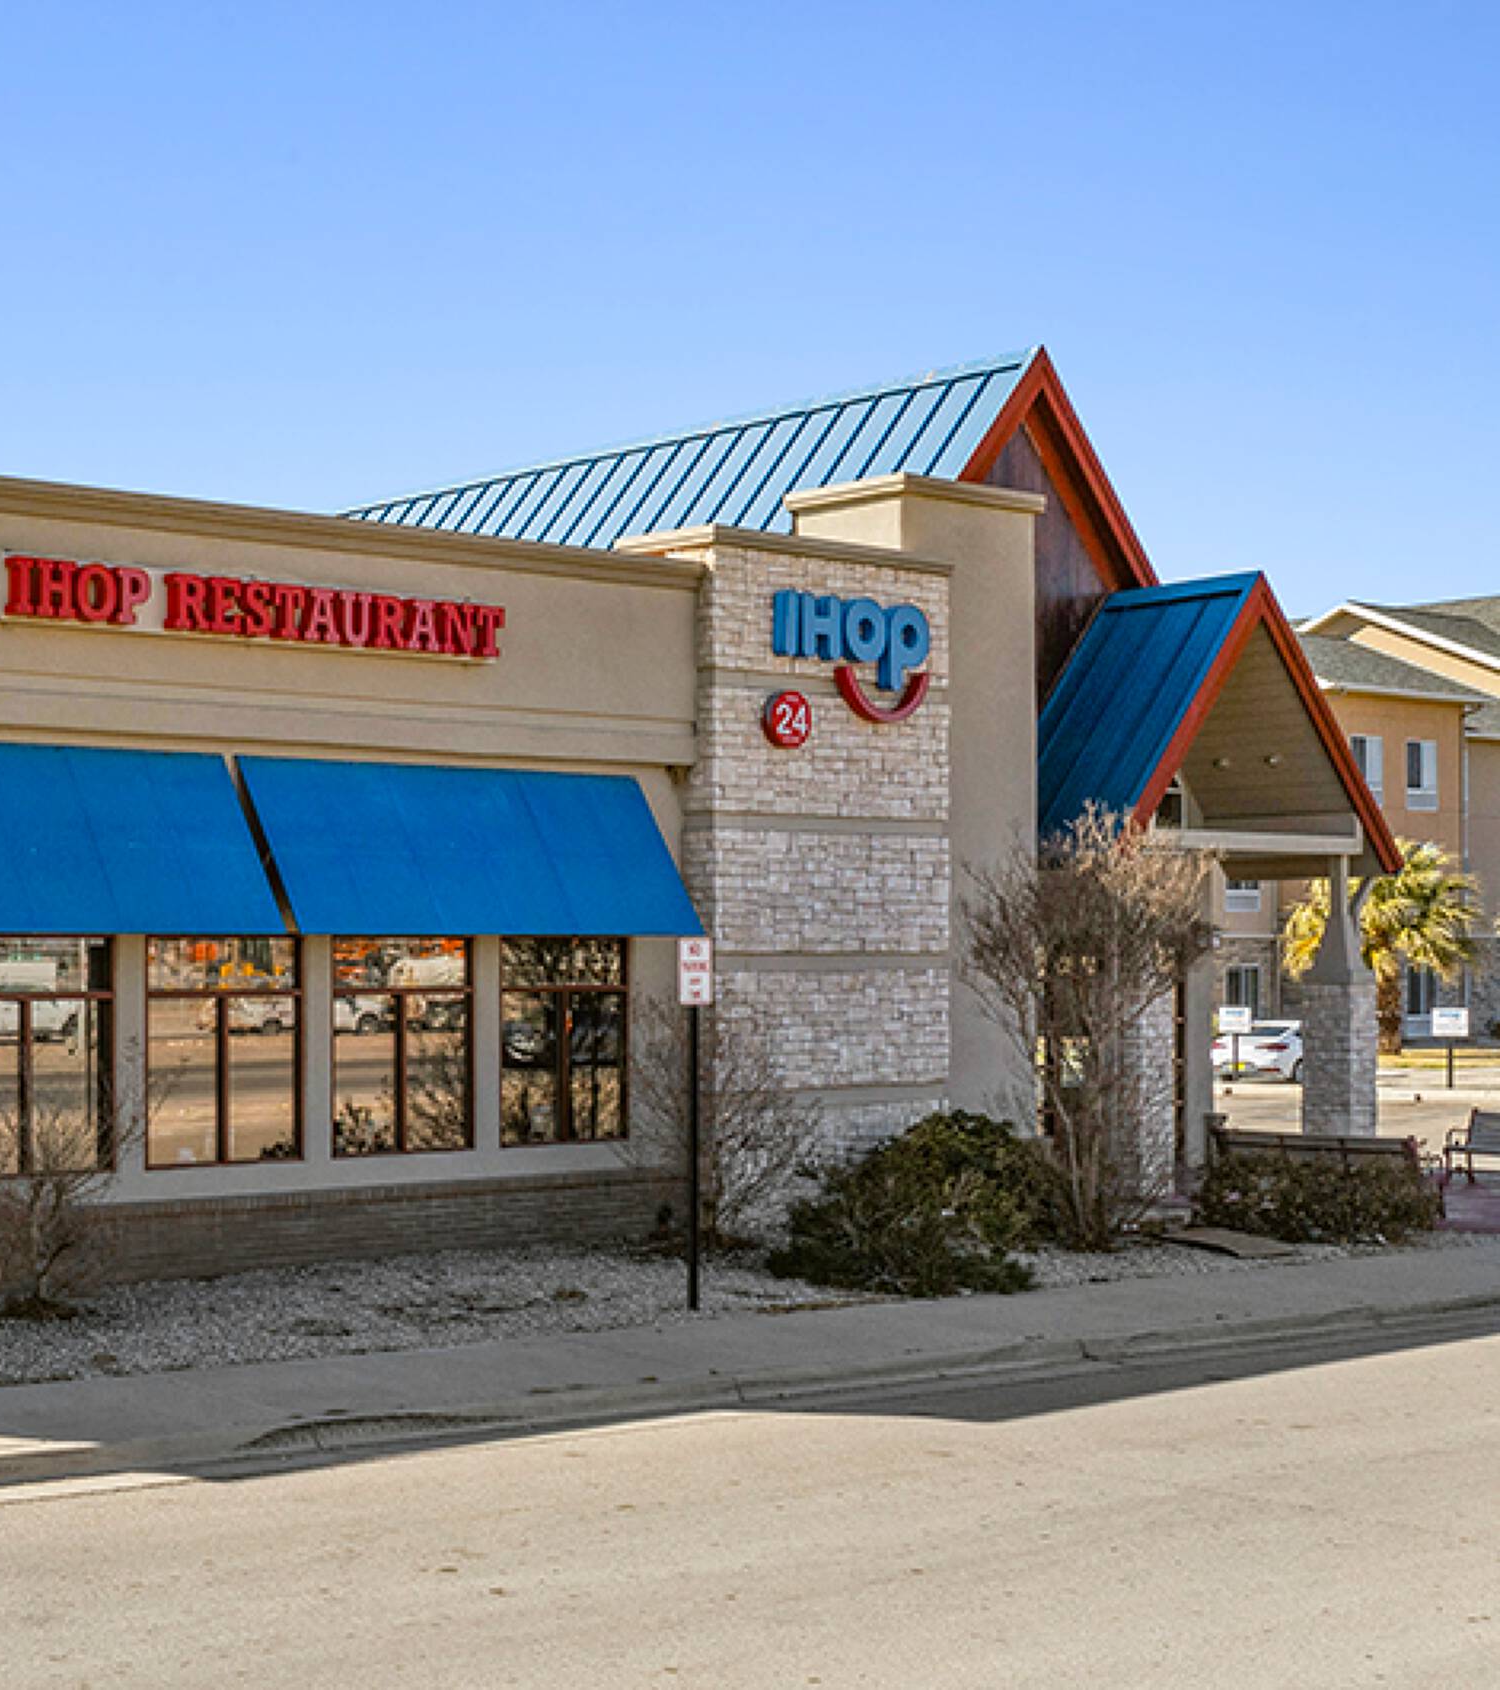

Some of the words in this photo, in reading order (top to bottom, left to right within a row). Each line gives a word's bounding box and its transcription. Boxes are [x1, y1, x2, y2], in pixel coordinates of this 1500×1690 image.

[3, 555, 149, 625] IHOP
[163, 572, 506, 658] RESTAURANT
[776, 703, 807, 735] 24
